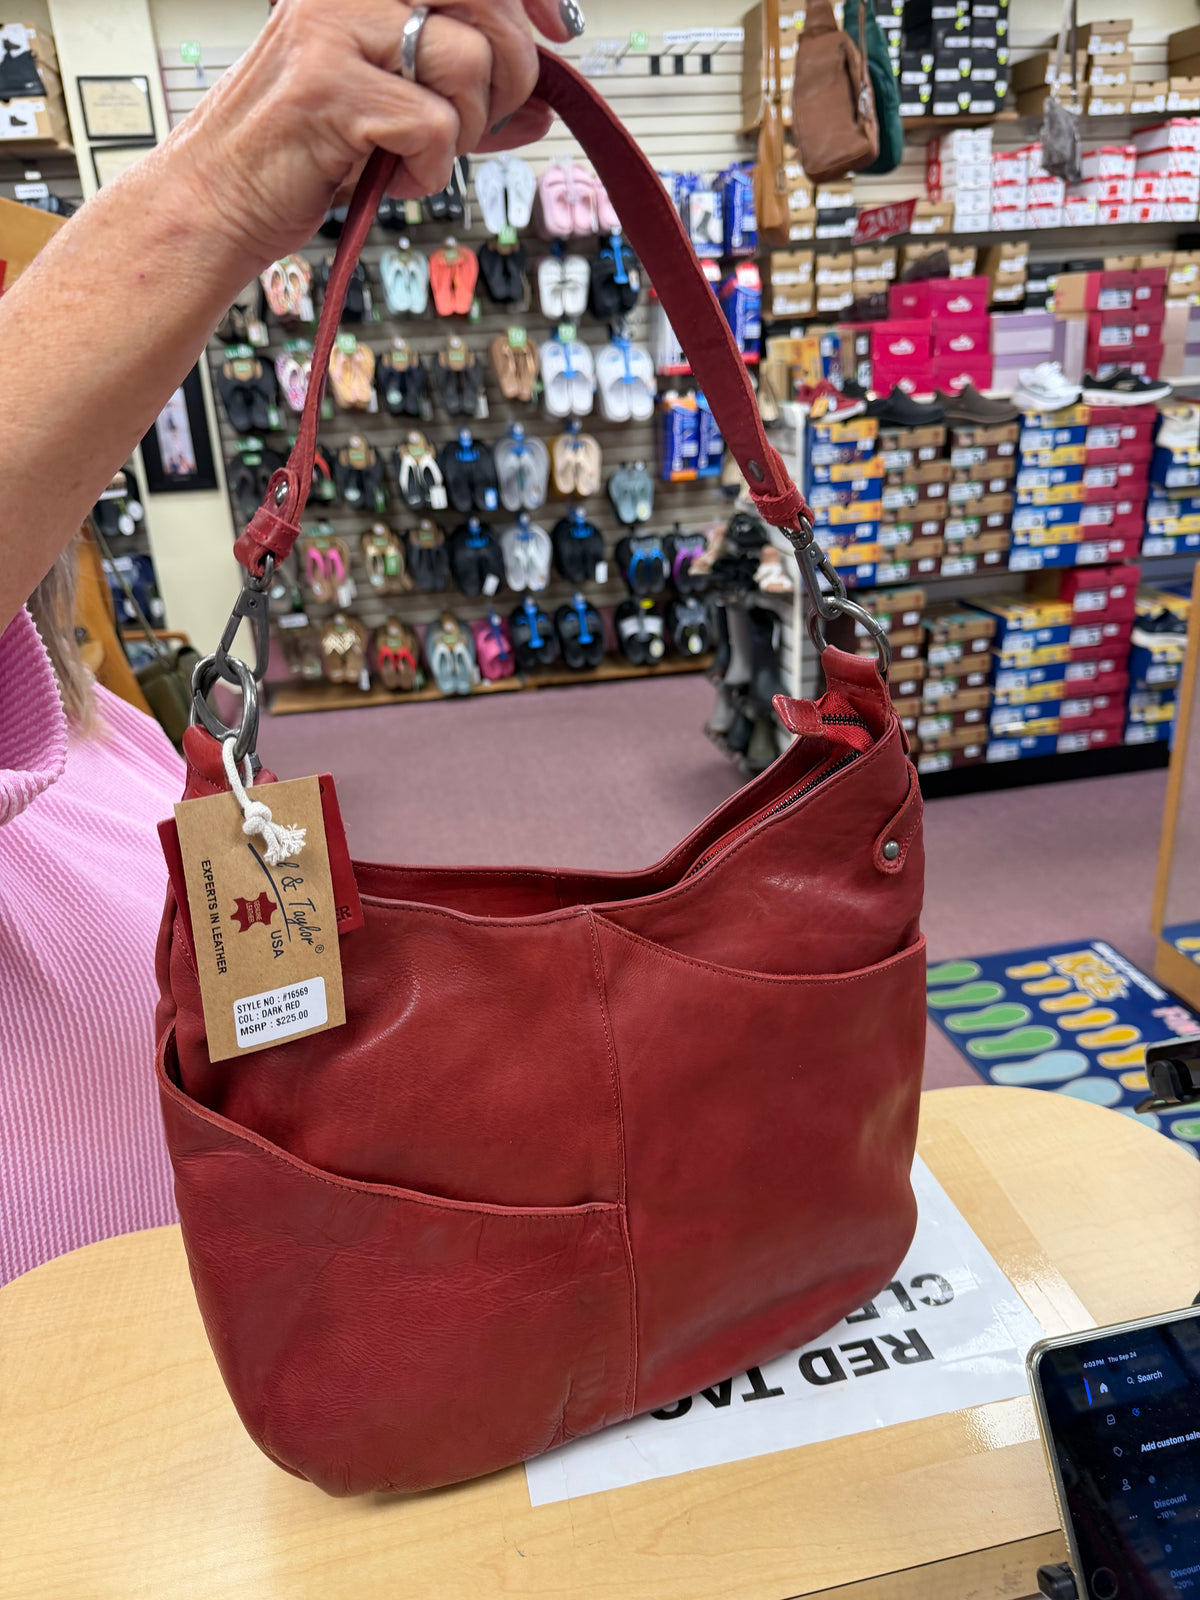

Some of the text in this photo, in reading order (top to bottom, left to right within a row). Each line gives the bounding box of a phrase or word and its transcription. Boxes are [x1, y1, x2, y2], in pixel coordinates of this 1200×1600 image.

[281, 876, 304, 892] &
[201, 859, 228, 975] EXPERTS IN LEATHER
[270, 929, 284, 959] USA
[236, 1000, 261, 1014] STYLE
[263, 996, 275, 1007] NO
[282, 986, 309, 1002] #16569
[238, 1013, 254, 1025] COL
[261, 1005, 283, 1019] DARK
[285, 1000, 301, 1012] RED
[240, 1022, 267, 1036] MSRP
[275, 1009, 309, 1026] $225.00
[798, 1328, 935, 1386] RED
[1137, 1370, 1163, 1383] Search
[1141, 1441, 1156, 1452] Add
[1156, 1436, 1185, 1448] custom
[1153, 1493, 1188, 1509] Discount
[1170, 1564, 1200, 1579] Discoun
